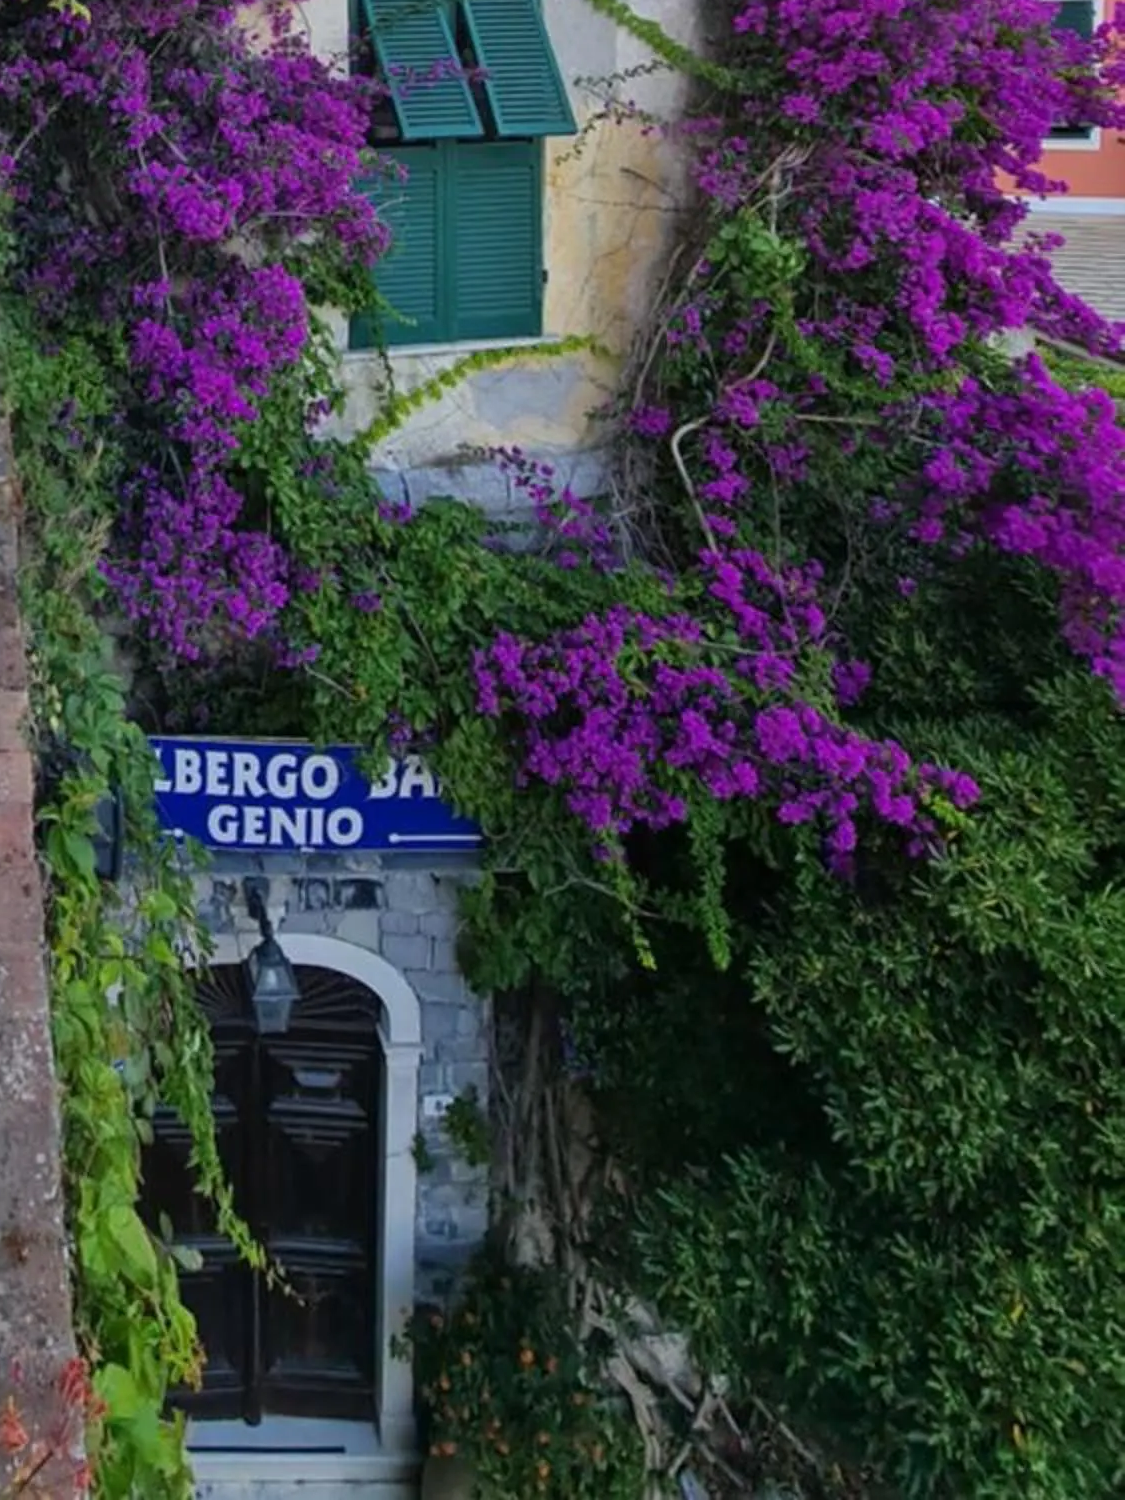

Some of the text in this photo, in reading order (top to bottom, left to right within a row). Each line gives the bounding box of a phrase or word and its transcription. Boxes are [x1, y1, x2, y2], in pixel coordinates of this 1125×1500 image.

[153, 748, 444, 800] LBERGO BA
[207, 804, 364, 846] GENIO
